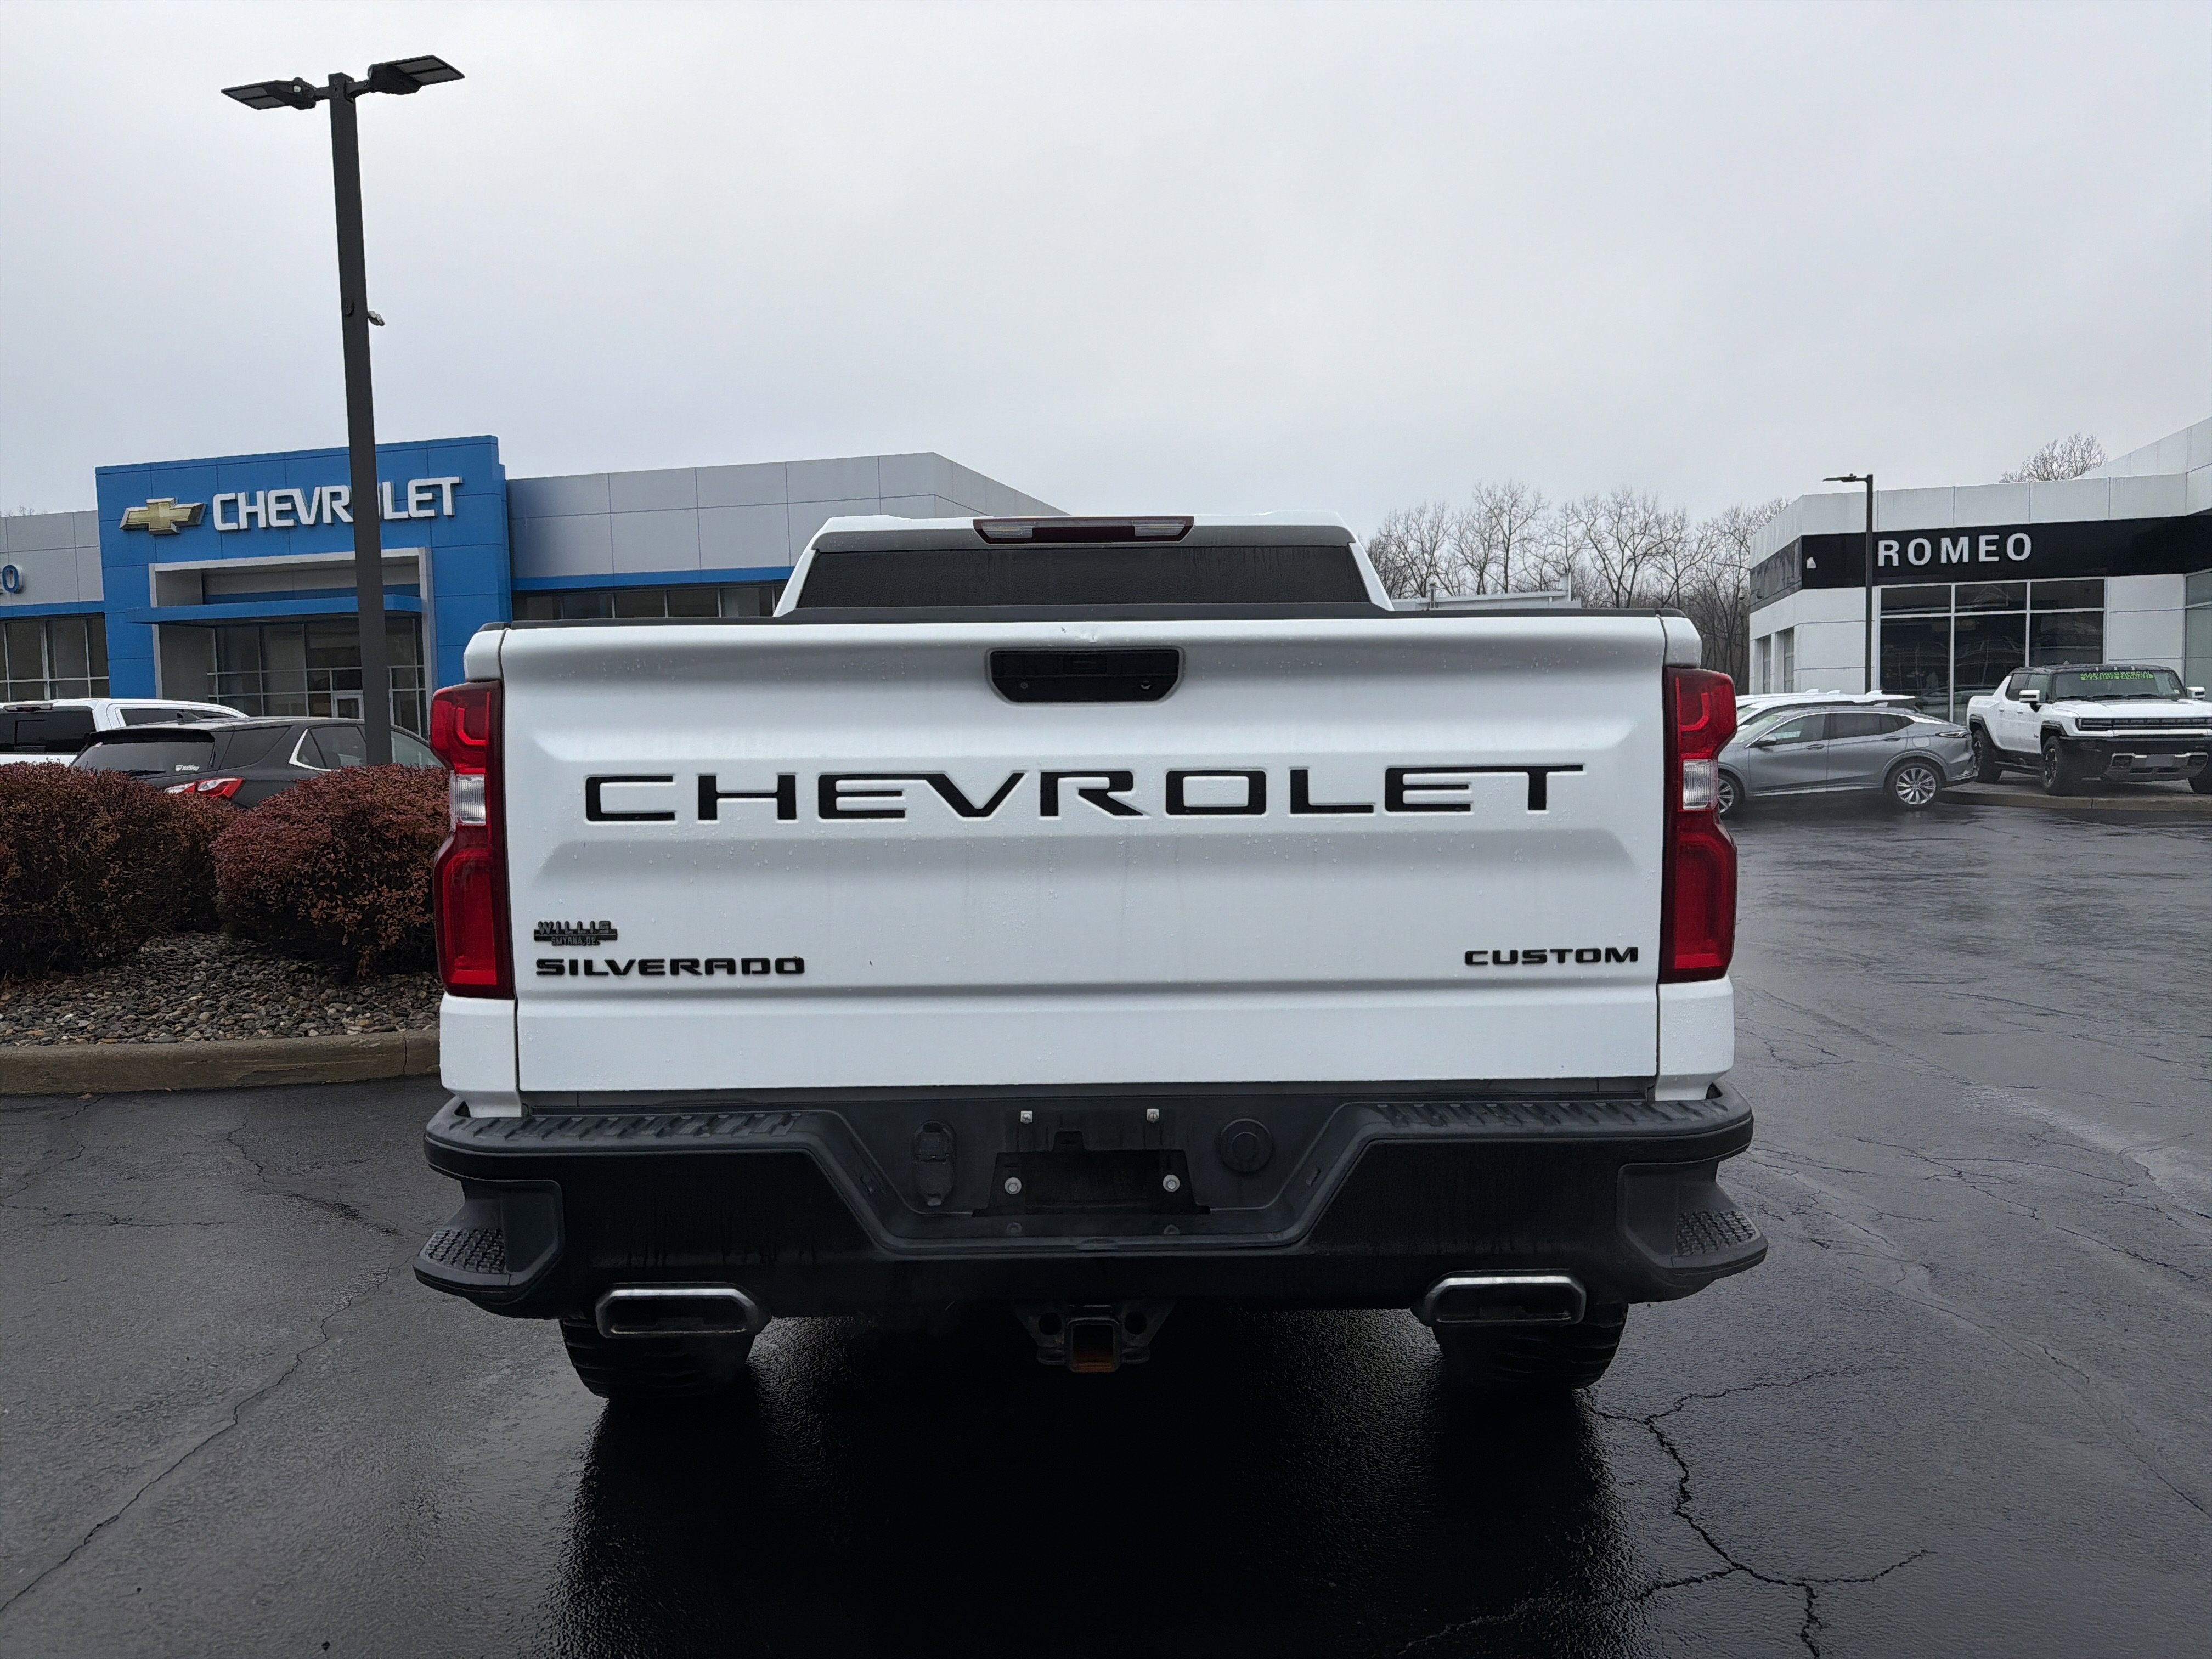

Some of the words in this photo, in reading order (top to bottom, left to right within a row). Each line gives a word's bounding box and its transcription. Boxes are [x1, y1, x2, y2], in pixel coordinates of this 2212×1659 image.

[212, 476, 462, 531] CHEVRLET
[1878, 533, 2032, 567] ROMEO
[585, 765, 1584, 822] CHEVROLET
[538, 921, 611, 934] WILLIS
[536, 958, 805, 976] SILVERADO
[1465, 947, 1639, 966] CUSTOM
